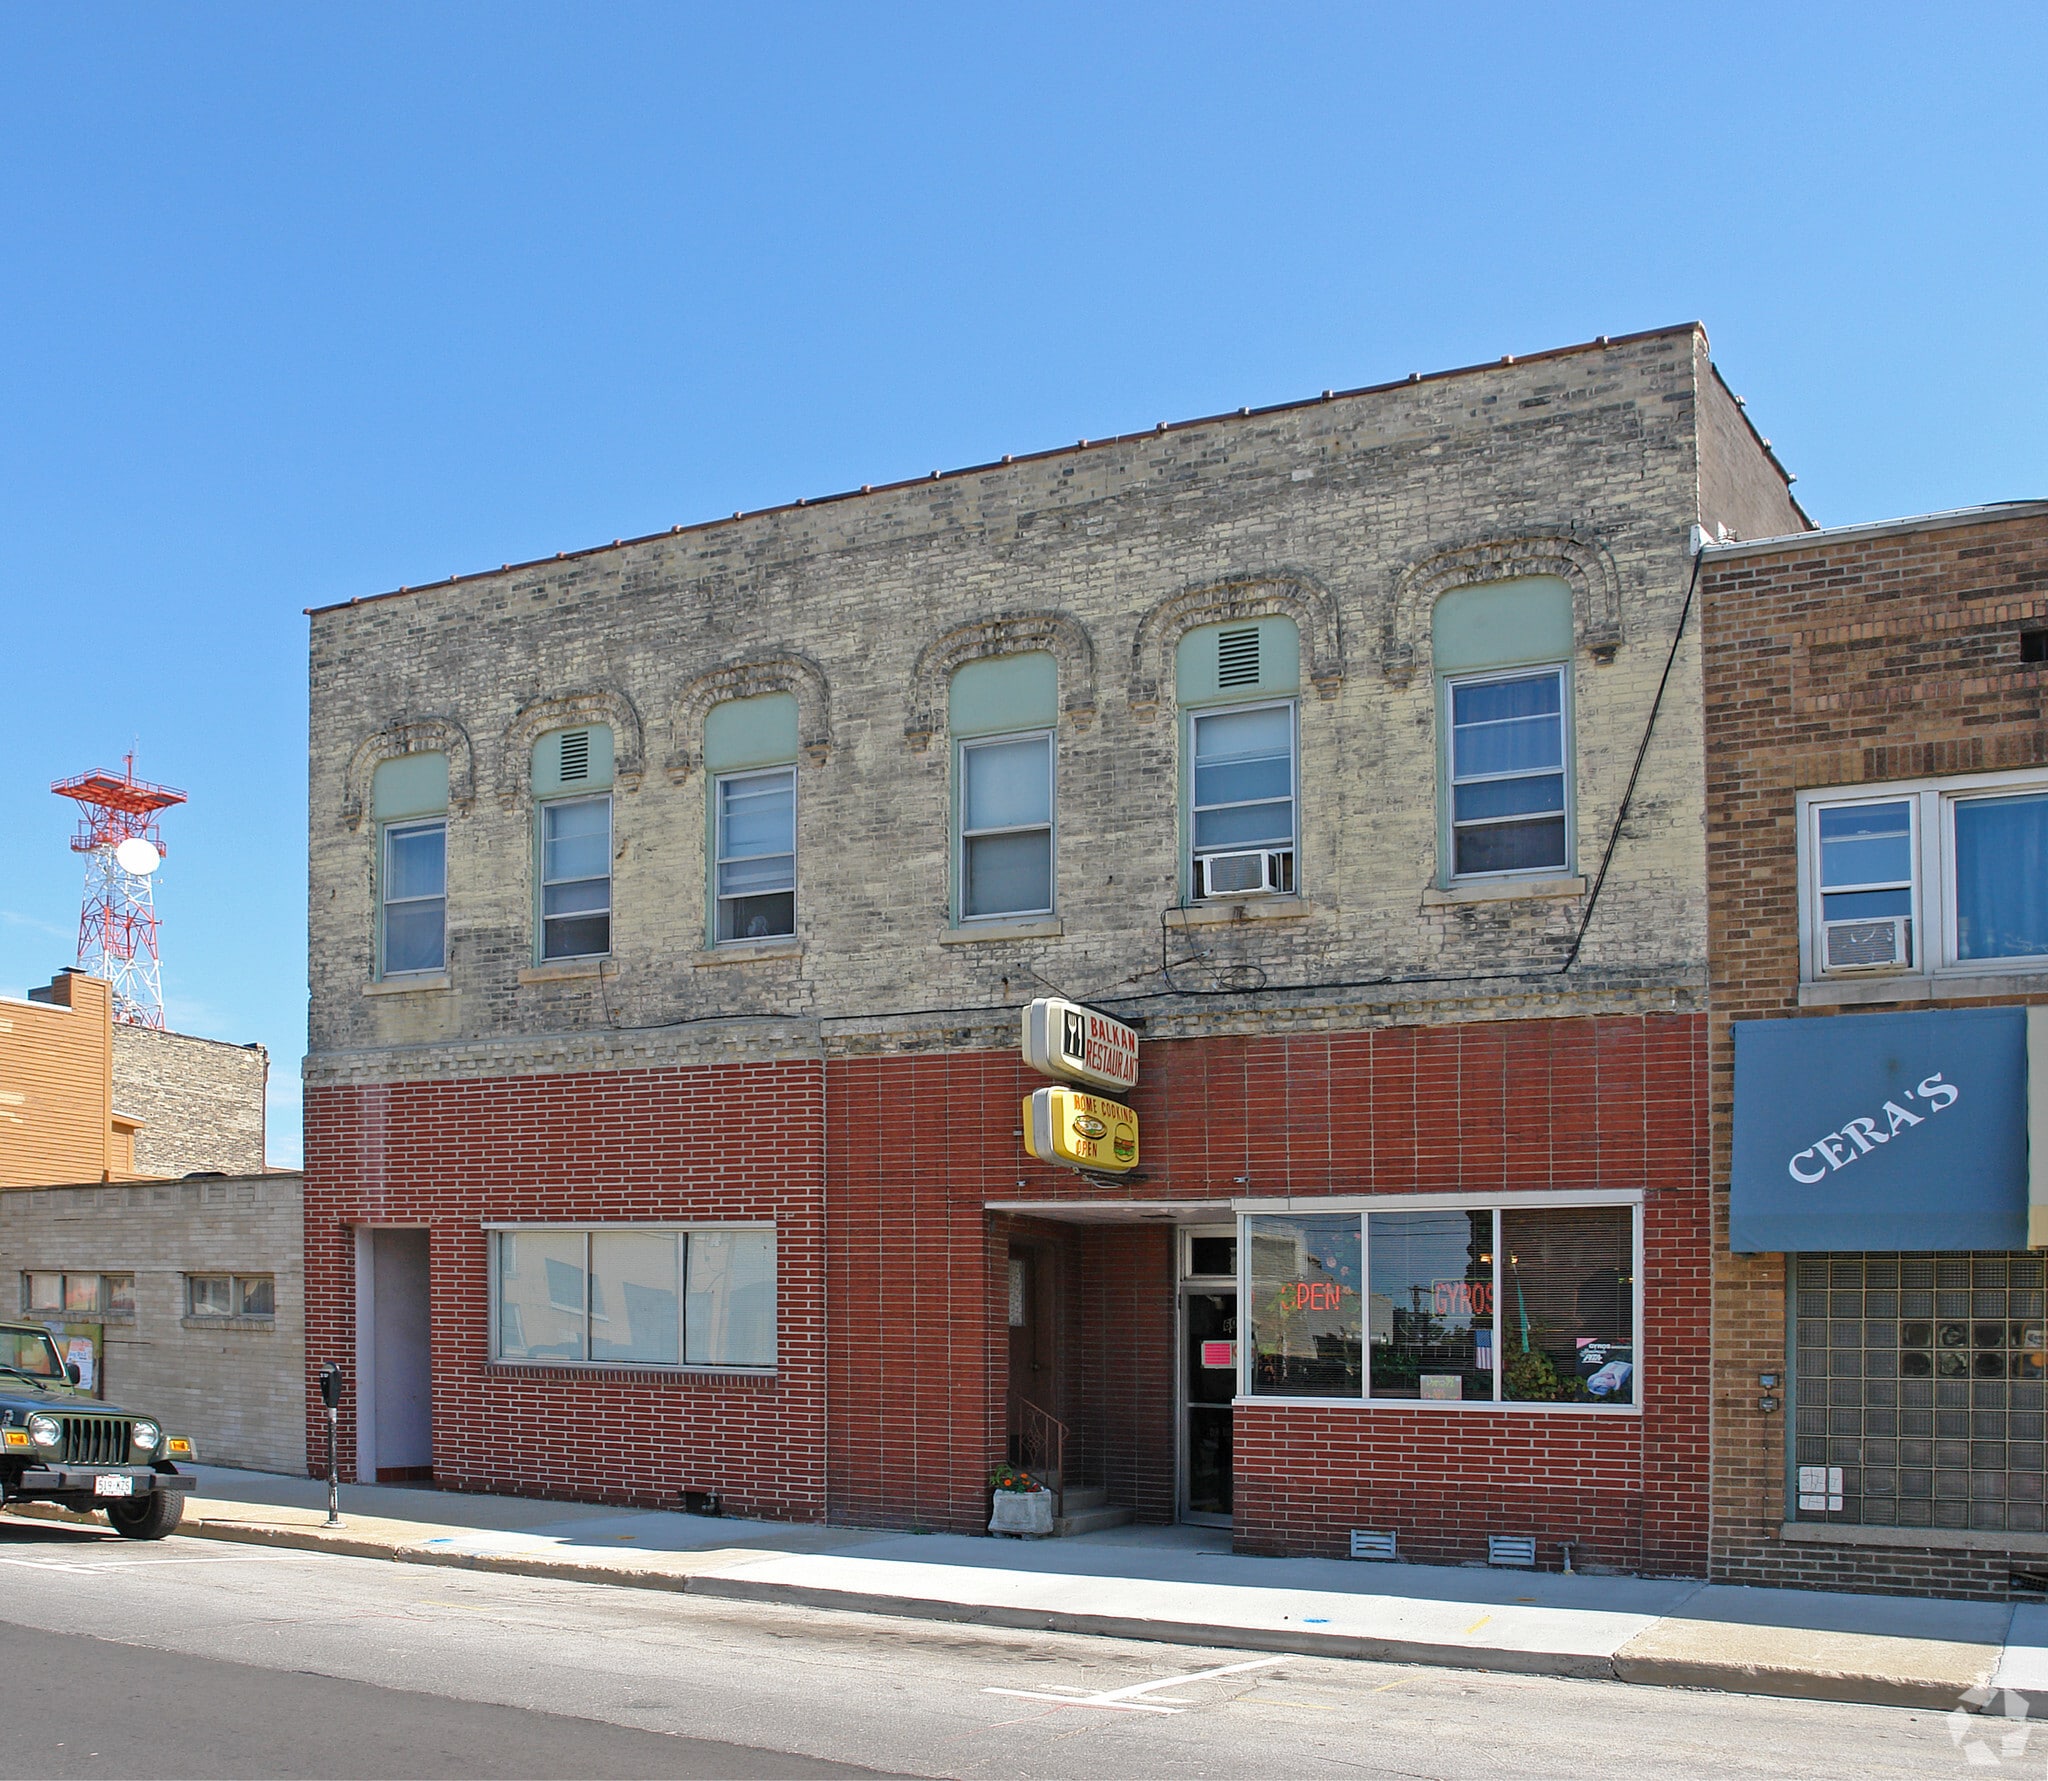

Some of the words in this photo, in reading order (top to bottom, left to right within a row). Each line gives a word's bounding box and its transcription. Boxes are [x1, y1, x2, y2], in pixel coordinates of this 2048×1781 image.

[1090, 1016, 1135, 1053] BALKAN
[1085, 1039, 1139, 1083] RESTAURANT
[1073, 1094, 1098, 1114] HOME
[1100, 1101, 1134, 1123] COOKING
[1788, 1071, 1959, 1184] CERA'S
[1075, 1140, 1098, 1158] OPEN
[1434, 1282, 1494, 1315] GYROS
